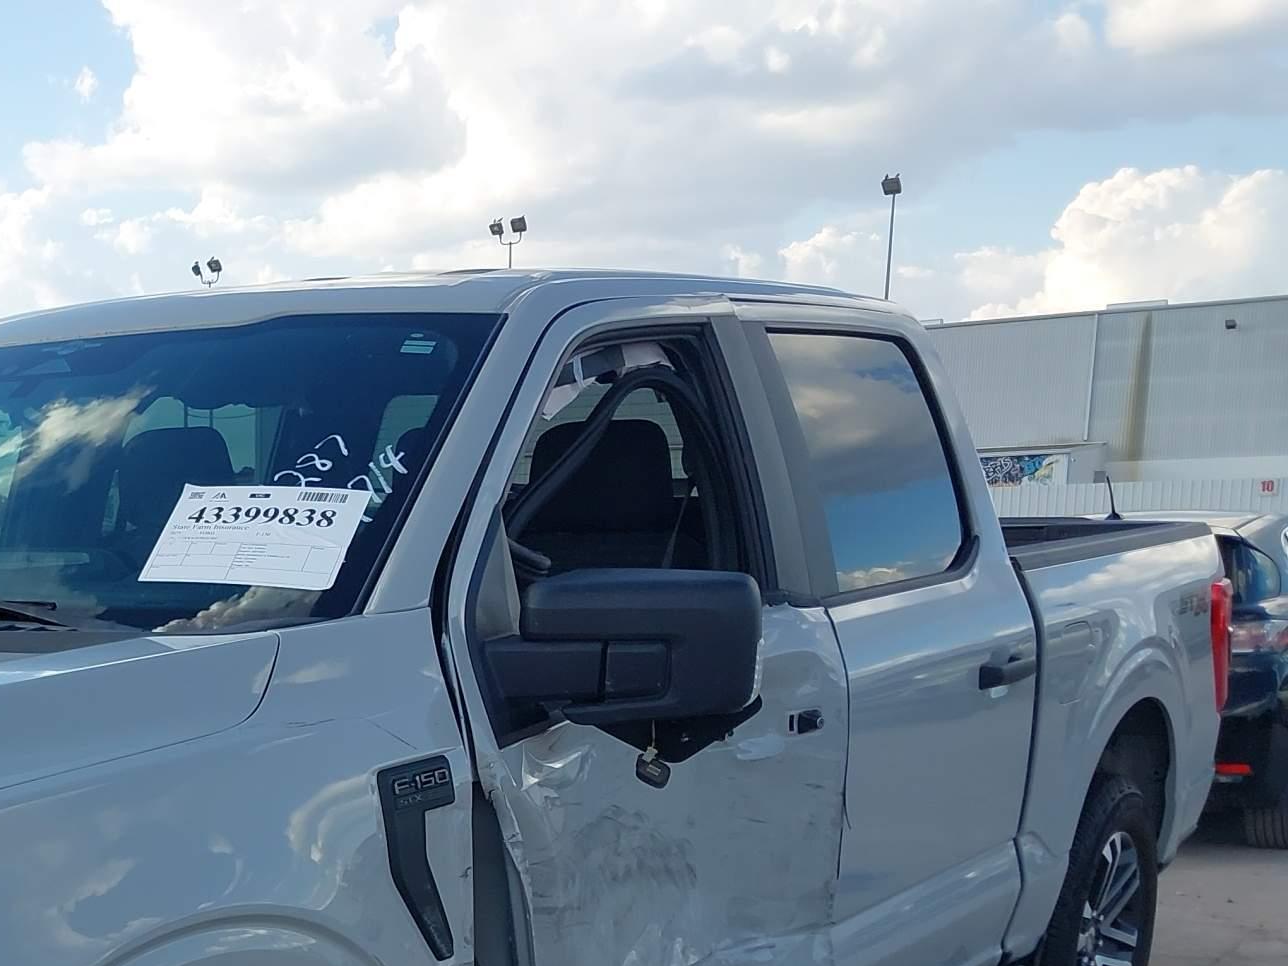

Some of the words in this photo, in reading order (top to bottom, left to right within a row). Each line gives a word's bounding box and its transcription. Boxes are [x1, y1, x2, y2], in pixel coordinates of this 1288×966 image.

[1261, 480, 1274, 492] 10
[187, 506, 337, 528] 43399838
[393, 768, 450, 795] F-150
